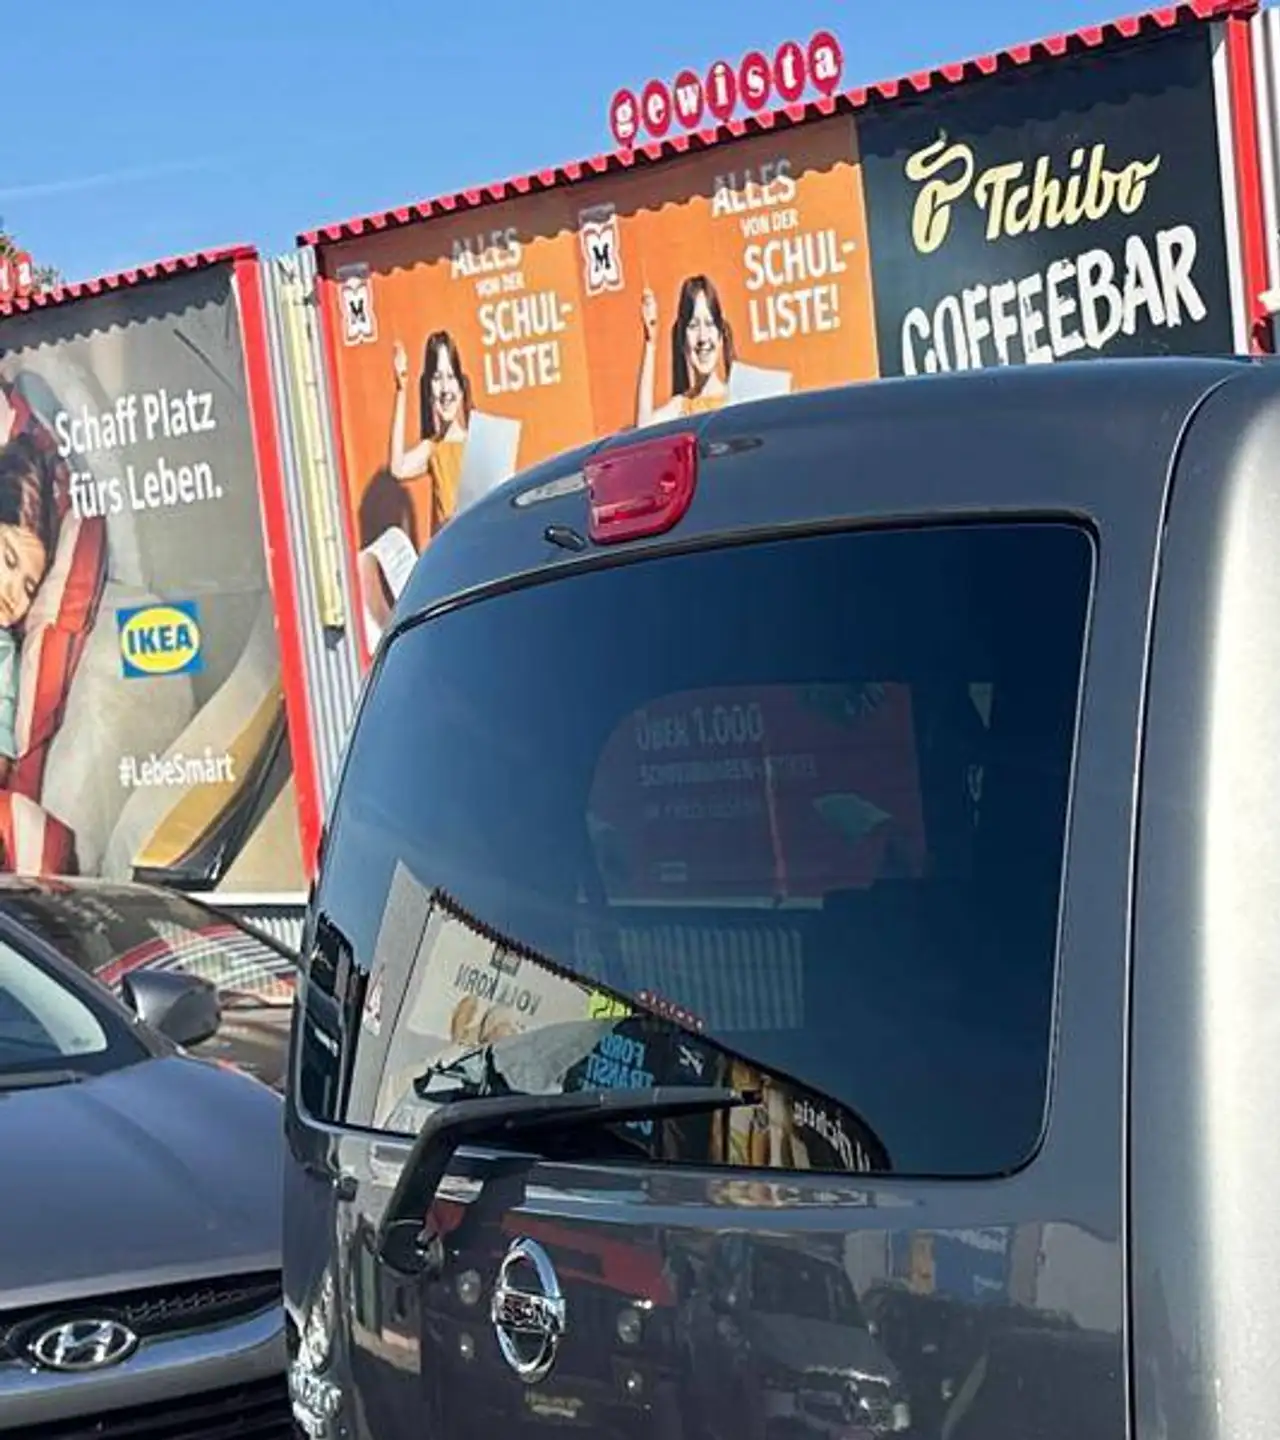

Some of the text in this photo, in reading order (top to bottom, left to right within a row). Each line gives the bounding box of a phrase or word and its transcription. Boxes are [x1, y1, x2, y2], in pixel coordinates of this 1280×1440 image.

[612, 43, 840, 139] gewista
[711, 158, 797, 217] ALLES
[974, 143, 1161, 240] Tchibo
[451, 227, 523, 279] ALLES
[744, 229, 856, 291] SCHUL-
[478, 291, 574, 346] SCHUL-
[749, 284, 841, 344] LISTE!
[902, 225, 1207, 377] COFFEEBAR
[484, 341, 562, 394] LISTE!
[55, 388, 217, 457] Schaff Platz
[69, 456, 223, 519] fürs Leben.
[127, 623, 194, 656] IKEA
